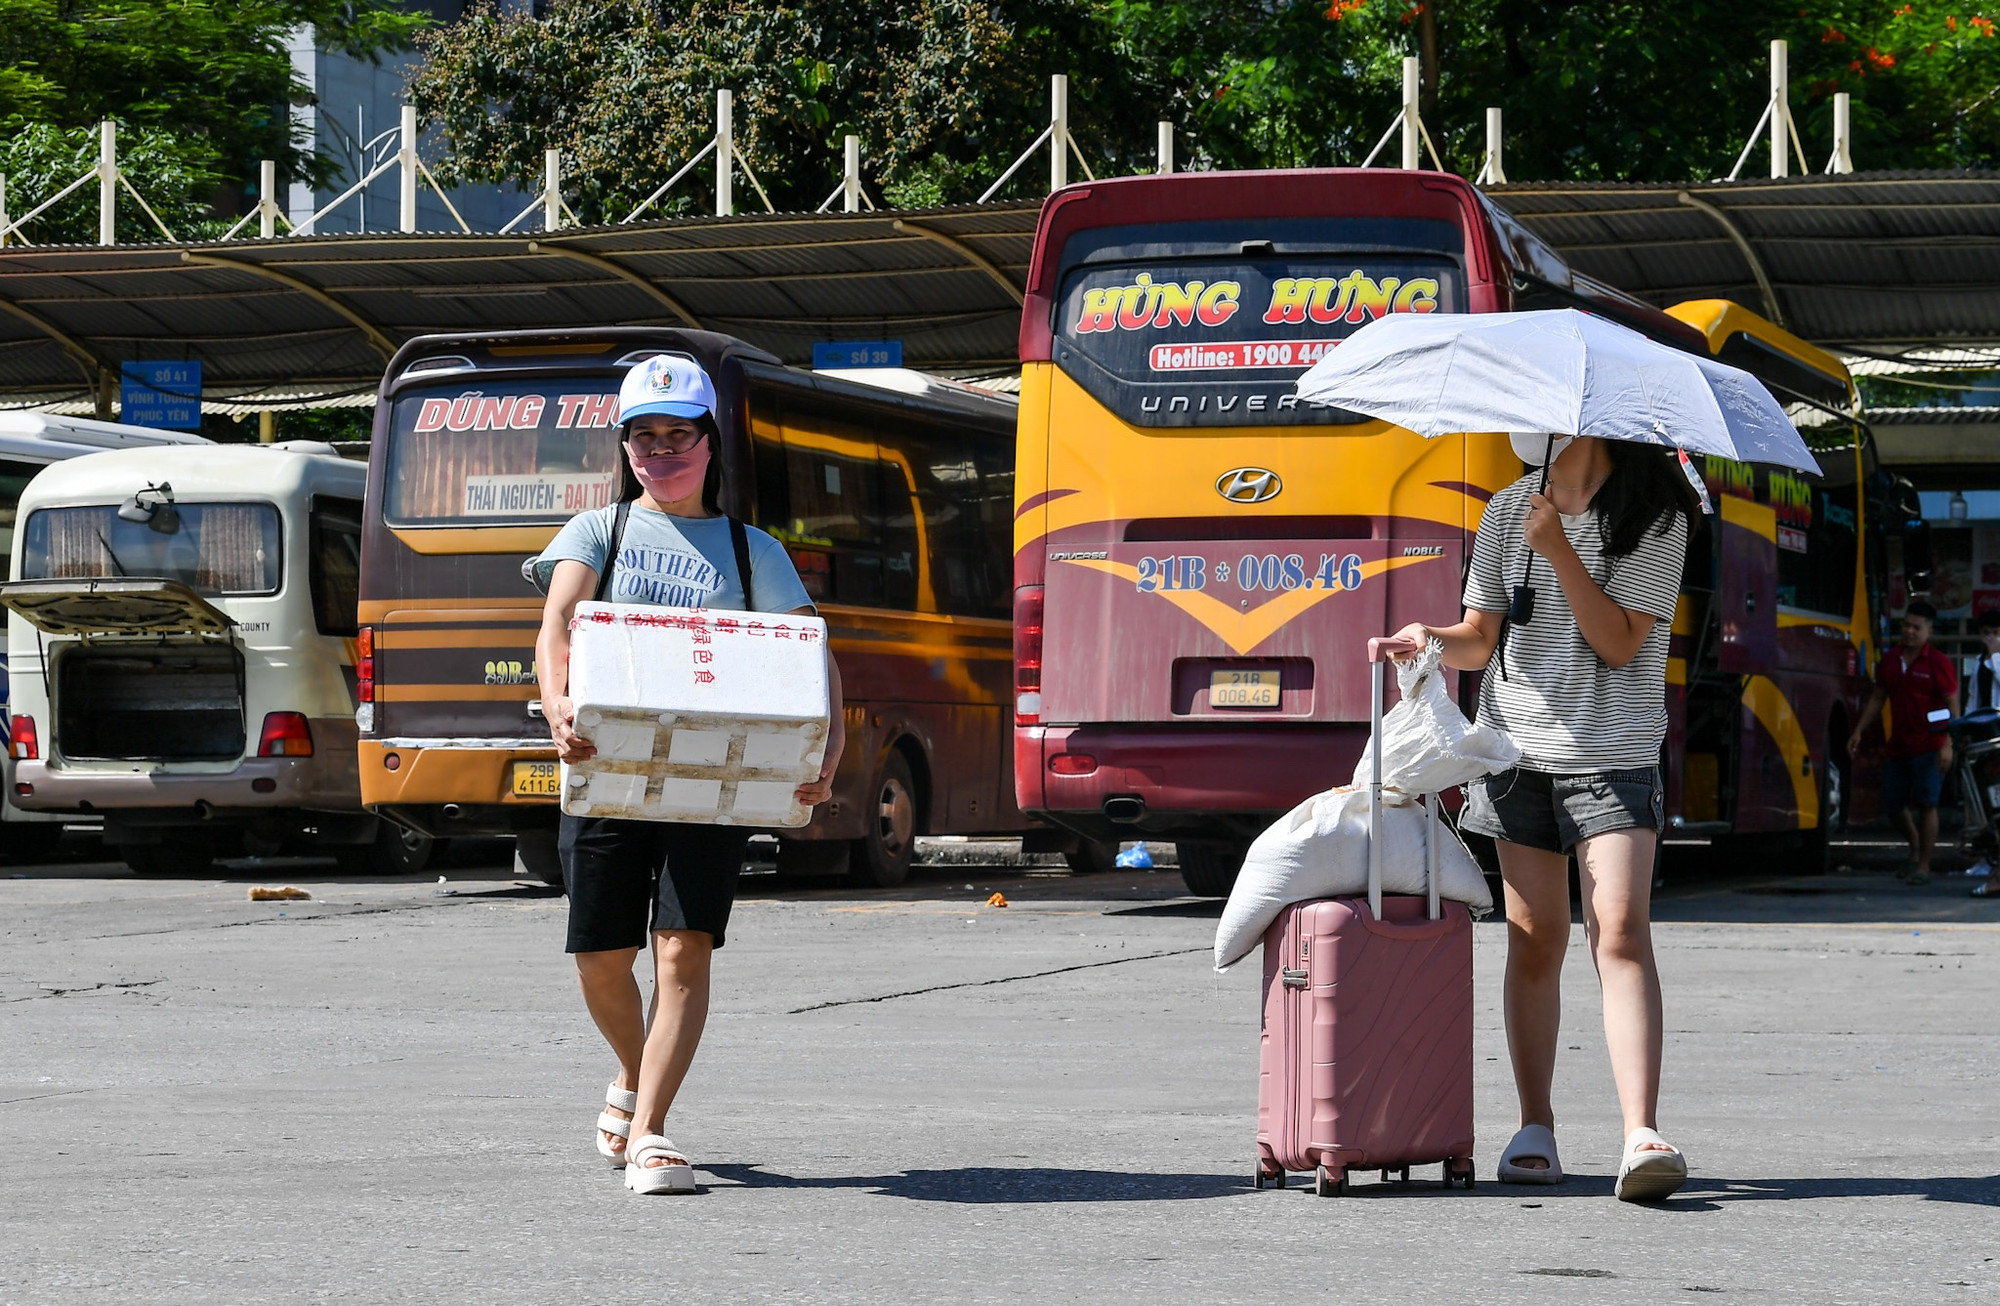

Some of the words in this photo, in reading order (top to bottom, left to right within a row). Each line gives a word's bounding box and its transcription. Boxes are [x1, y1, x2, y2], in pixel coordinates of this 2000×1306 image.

[1075, 272, 1241, 334] HÙNG
[1263, 269, 1439, 325] HƯNG
[851, 346, 869, 364] SỐ
[872, 351, 889, 364] 39
[1157, 346, 1235, 368] Hotline:
[1243, 345, 1292, 365] 1900
[154, 366, 171, 382] SỐ
[174, 371, 188, 382] 41
[127, 390, 154, 404] VĨNH
[132, 407, 163, 421] PHÚC
[167, 408, 189, 421] YÊN
[414, 391, 546, 432] DŨNG
[556, 394, 624, 429] TH
[467, 479, 497, 511] THÁI
[499, 479, 555, 510] NGUYÊN
[564, 483, 588, 512] ĐẠI
[593, 475, 612, 509] TỪ
[1050, 551, 1107, 561] UNIVERSE
[1403, 546, 1443, 556] NOBLE
[616, 548, 727, 591] SOUTHERN
[1136, 555, 1206, 592] 21B
[1238, 553, 1362, 591] 008.46
[618, 572, 708, 608] COMFORT
[240, 622, 271, 632] COUNTY
[1232, 673, 1260, 685] 21B
[1218, 689, 1271, 704] 008.46
[530, 765, 555, 777] 29B
